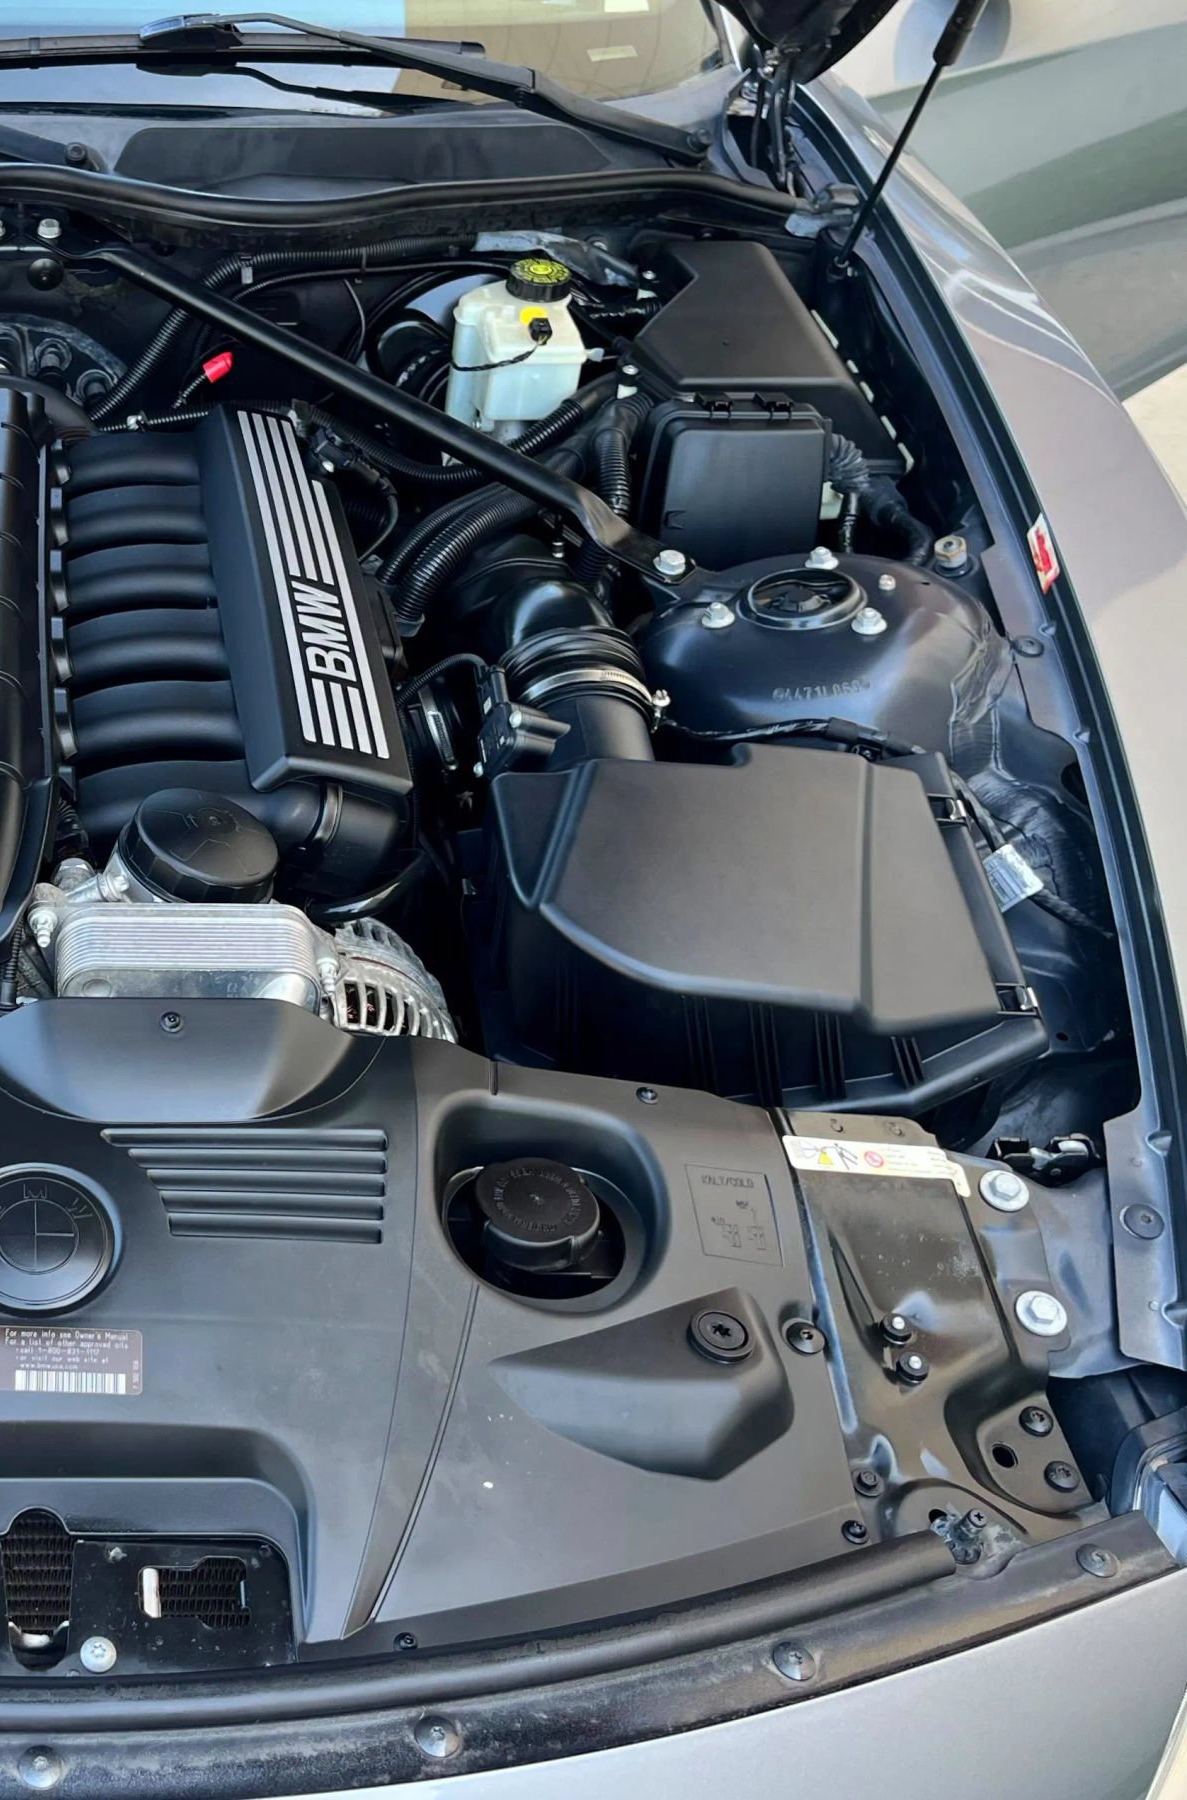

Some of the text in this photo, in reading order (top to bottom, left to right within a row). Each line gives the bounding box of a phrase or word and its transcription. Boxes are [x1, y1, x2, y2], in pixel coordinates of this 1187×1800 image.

[291, 580, 357, 682] BMW
[5, 1328, 17, 1337] For
[41, 1330, 56, 1338] info
[75, 1331, 101, 1340] Owner's
[105, 1332, 129, 1341] Manual
[20, 1346, 34, 1354] call
[29, 1338, 42, 1346] list
[45, 1339, 54, 1347] of
[57, 1339, 77, 1347] other
[79, 1340, 111, 1349] approved
[114, 1342, 129, 1350] oils
